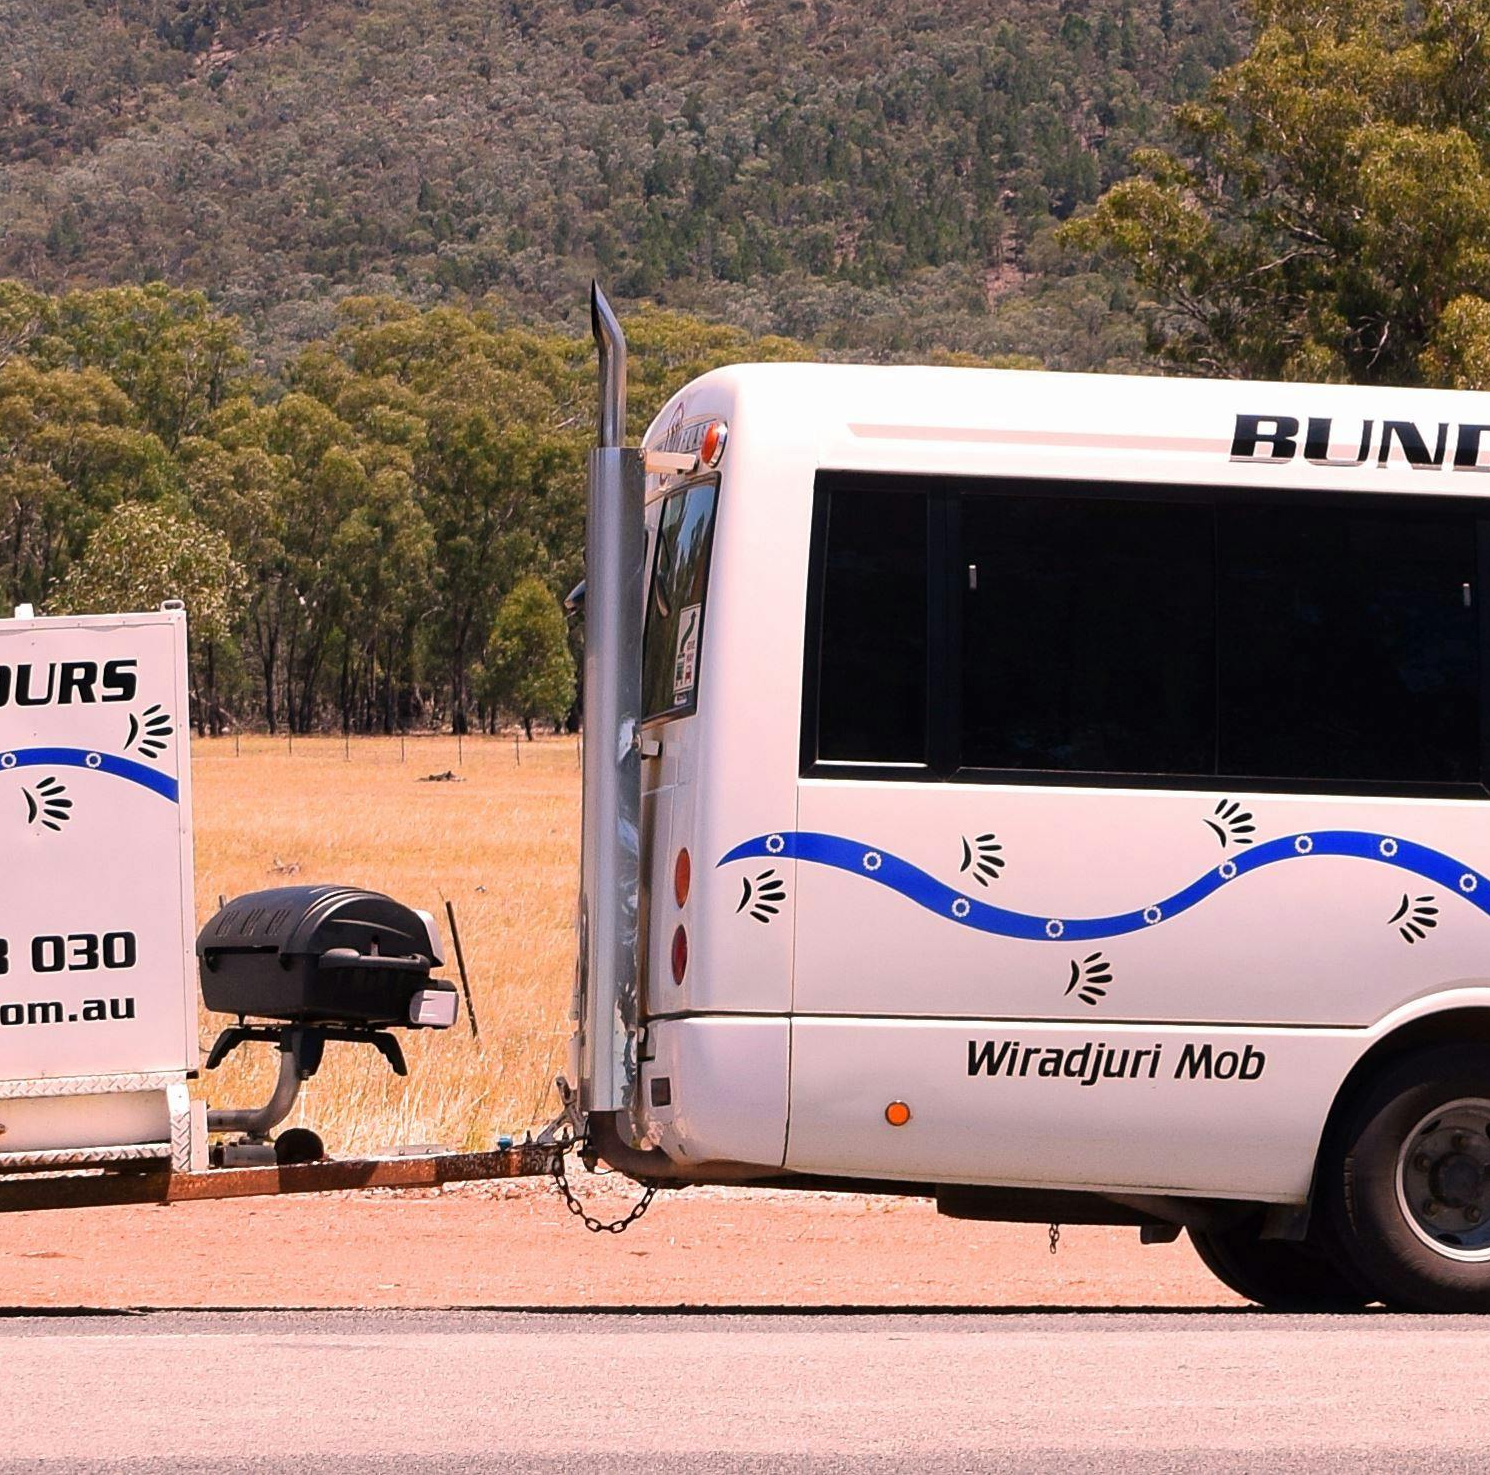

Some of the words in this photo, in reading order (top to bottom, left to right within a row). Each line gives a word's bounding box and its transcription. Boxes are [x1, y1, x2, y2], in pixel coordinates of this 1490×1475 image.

[32, 932, 136, 972] 030
[968, 1041, 1161, 1086] Wiradjuri
[1174, 1044, 1265, 1079] Mob
